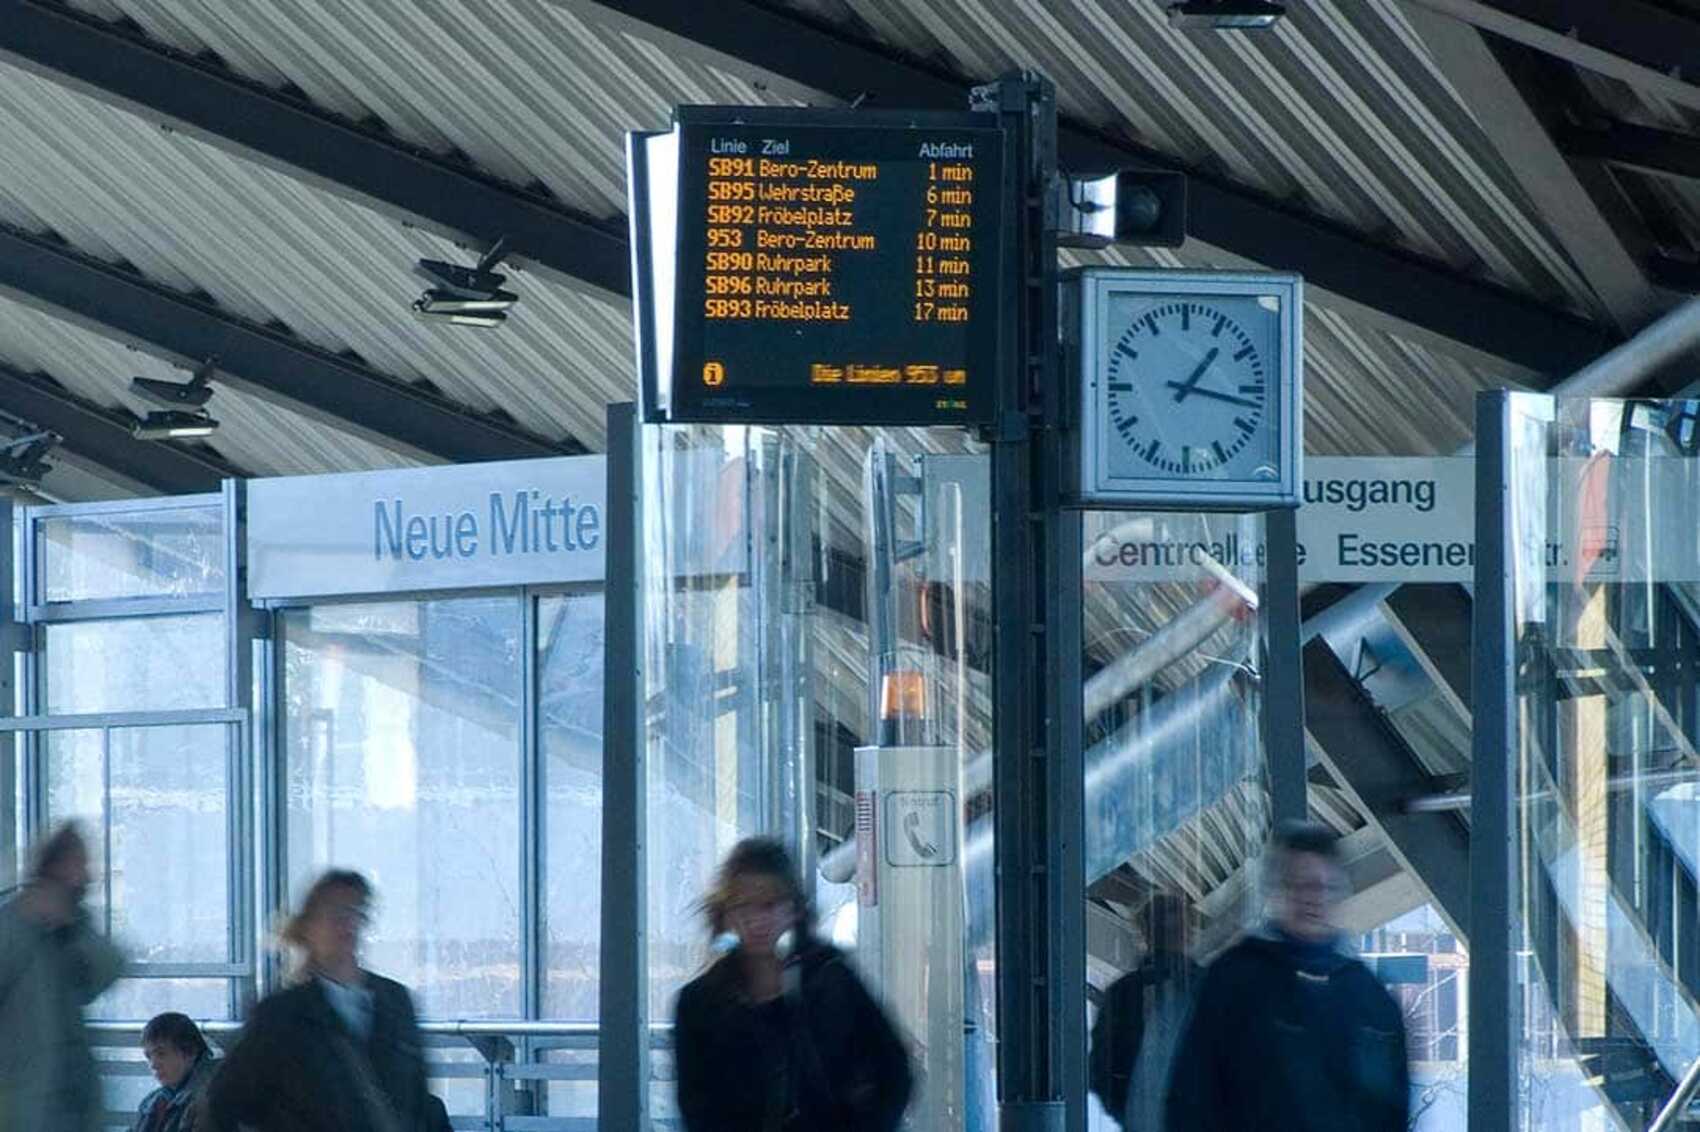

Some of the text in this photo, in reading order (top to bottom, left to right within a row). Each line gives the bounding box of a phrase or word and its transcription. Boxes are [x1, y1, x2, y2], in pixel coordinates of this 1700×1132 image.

[711, 138, 973, 158] Linie Ziel Abfahrt
[708, 158, 973, 181] SB91 Bero-Zentrum 1 min
[708, 182, 972, 206] SB95 Wehrstraße 6 min
[707, 205, 971, 228] SB92 Fröbelplatz 7 min
[707, 229, 970, 251] 953 Bero-Zentrum 10 min
[706, 253, 970, 276] SB90 Ruhrpark 11 min
[706, 276, 969, 298] SB96 Ruhrpark 13 min
[705, 300, 968, 321] SB93 Fröbelplatz 17 min
[1303, 479, 1436, 512] usgang
[374, 490, 600, 561] Neue Mitte
